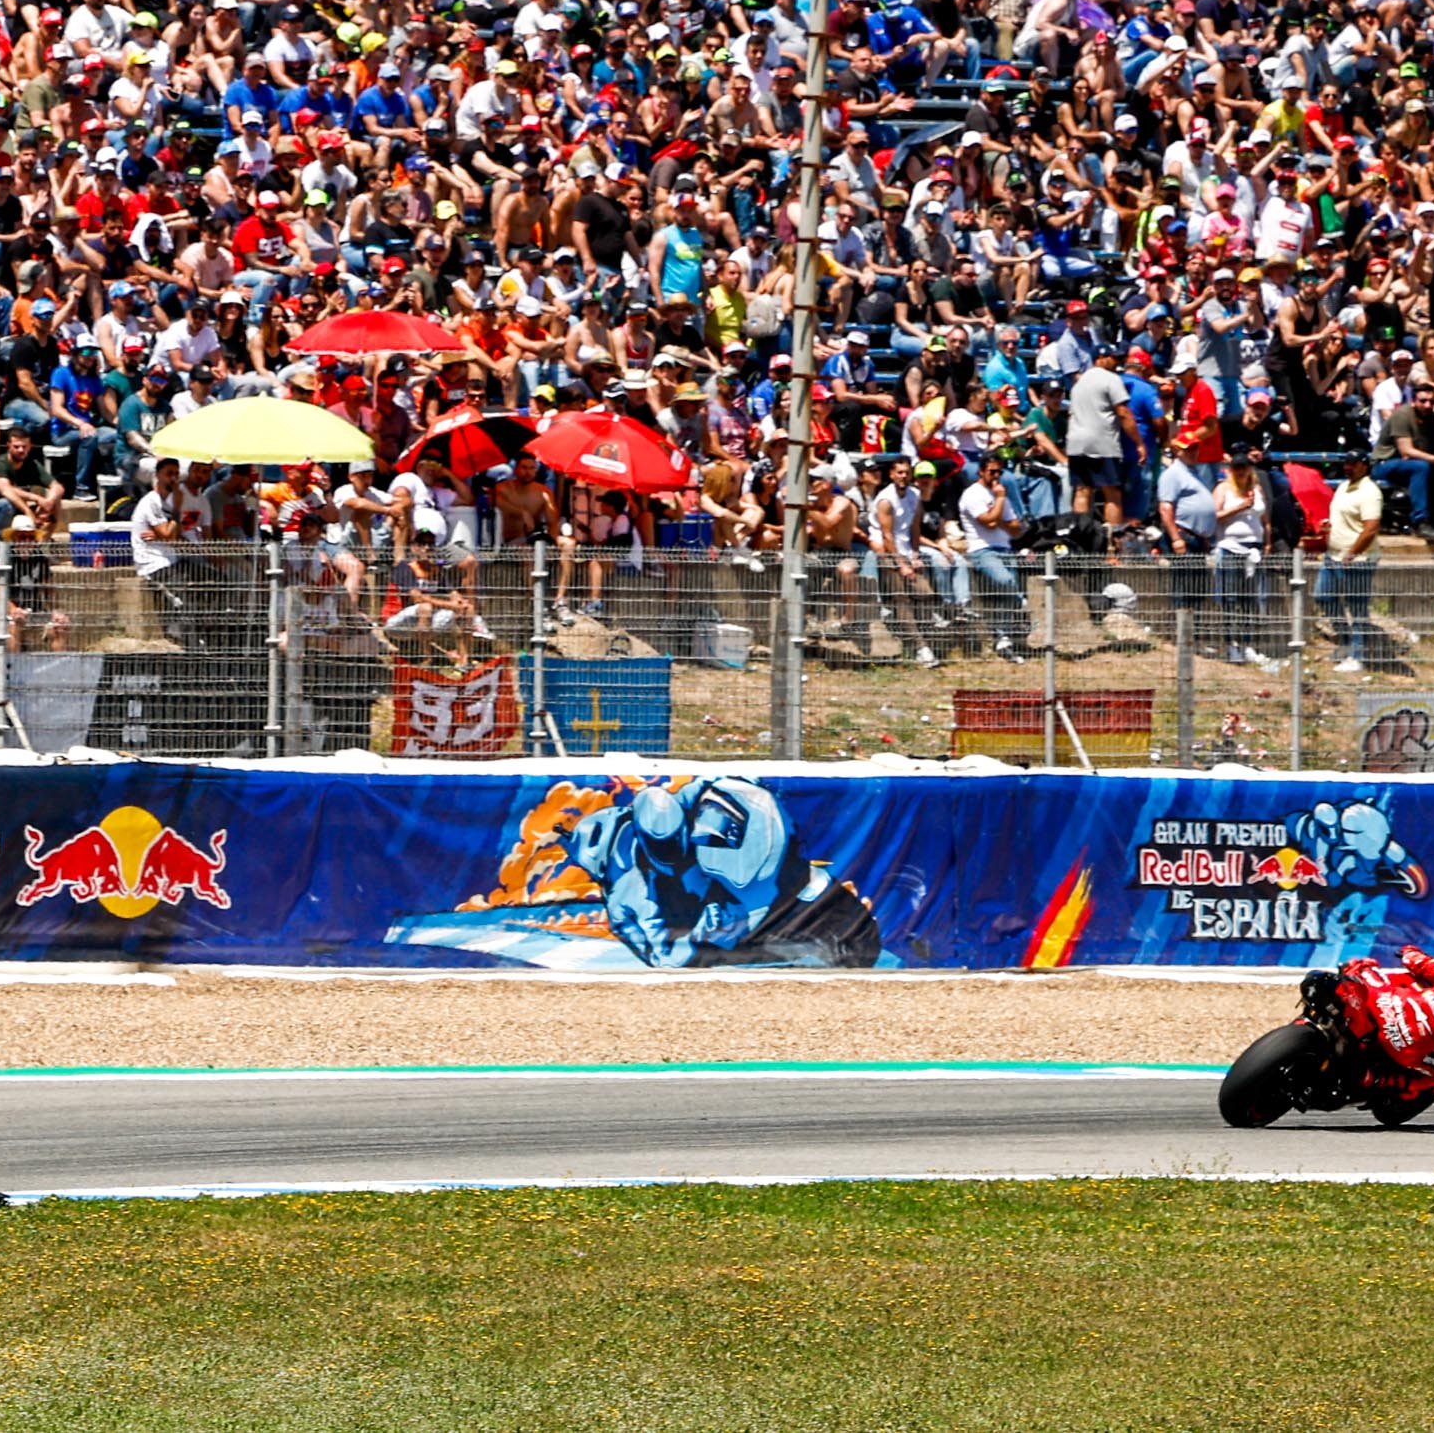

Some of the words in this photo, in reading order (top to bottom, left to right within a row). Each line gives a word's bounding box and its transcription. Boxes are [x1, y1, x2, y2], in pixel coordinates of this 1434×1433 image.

[1154, 822, 1208, 845] GRAN
[1216, 823, 1287, 846] PREMIO
[1140, 850, 1193, 886] Red
[1193, 850, 1244, 886] Bull
[1171, 889, 1193, 910] DE
[1192, 891, 1322, 940] ESPAÑA
